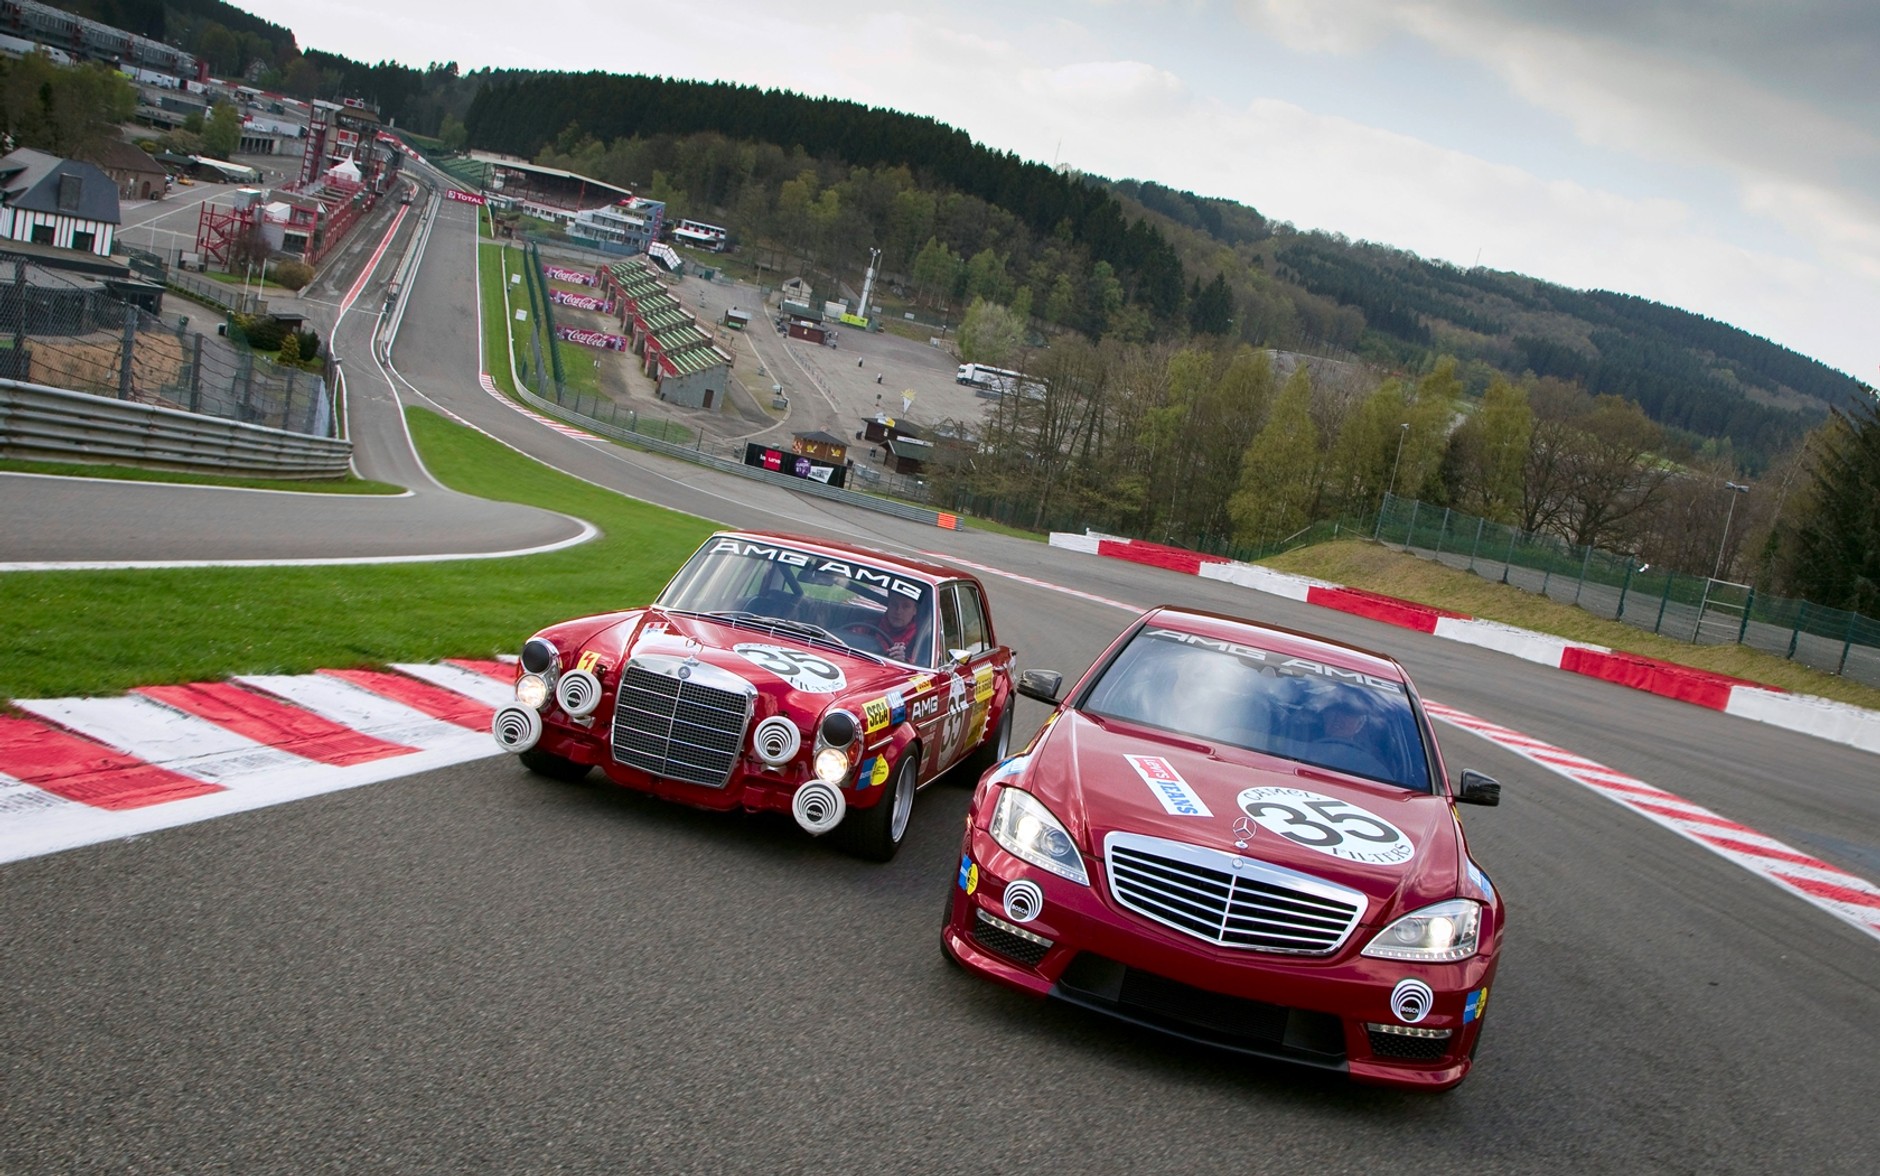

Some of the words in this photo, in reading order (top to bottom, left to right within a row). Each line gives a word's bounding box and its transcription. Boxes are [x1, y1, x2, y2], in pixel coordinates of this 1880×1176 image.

[457, 192, 483, 204] TOTAL
[709, 542, 809, 567] AMG
[818, 562, 922, 600] AMG
[737, 649, 840, 680] 35
[1146, 629, 1267, 661] AMG
[1281, 658, 1401, 694] AMG
[911, 695, 938, 721] AMG
[1157, 781, 1199, 814] JEANS
[1245, 801, 1400, 847] 35
